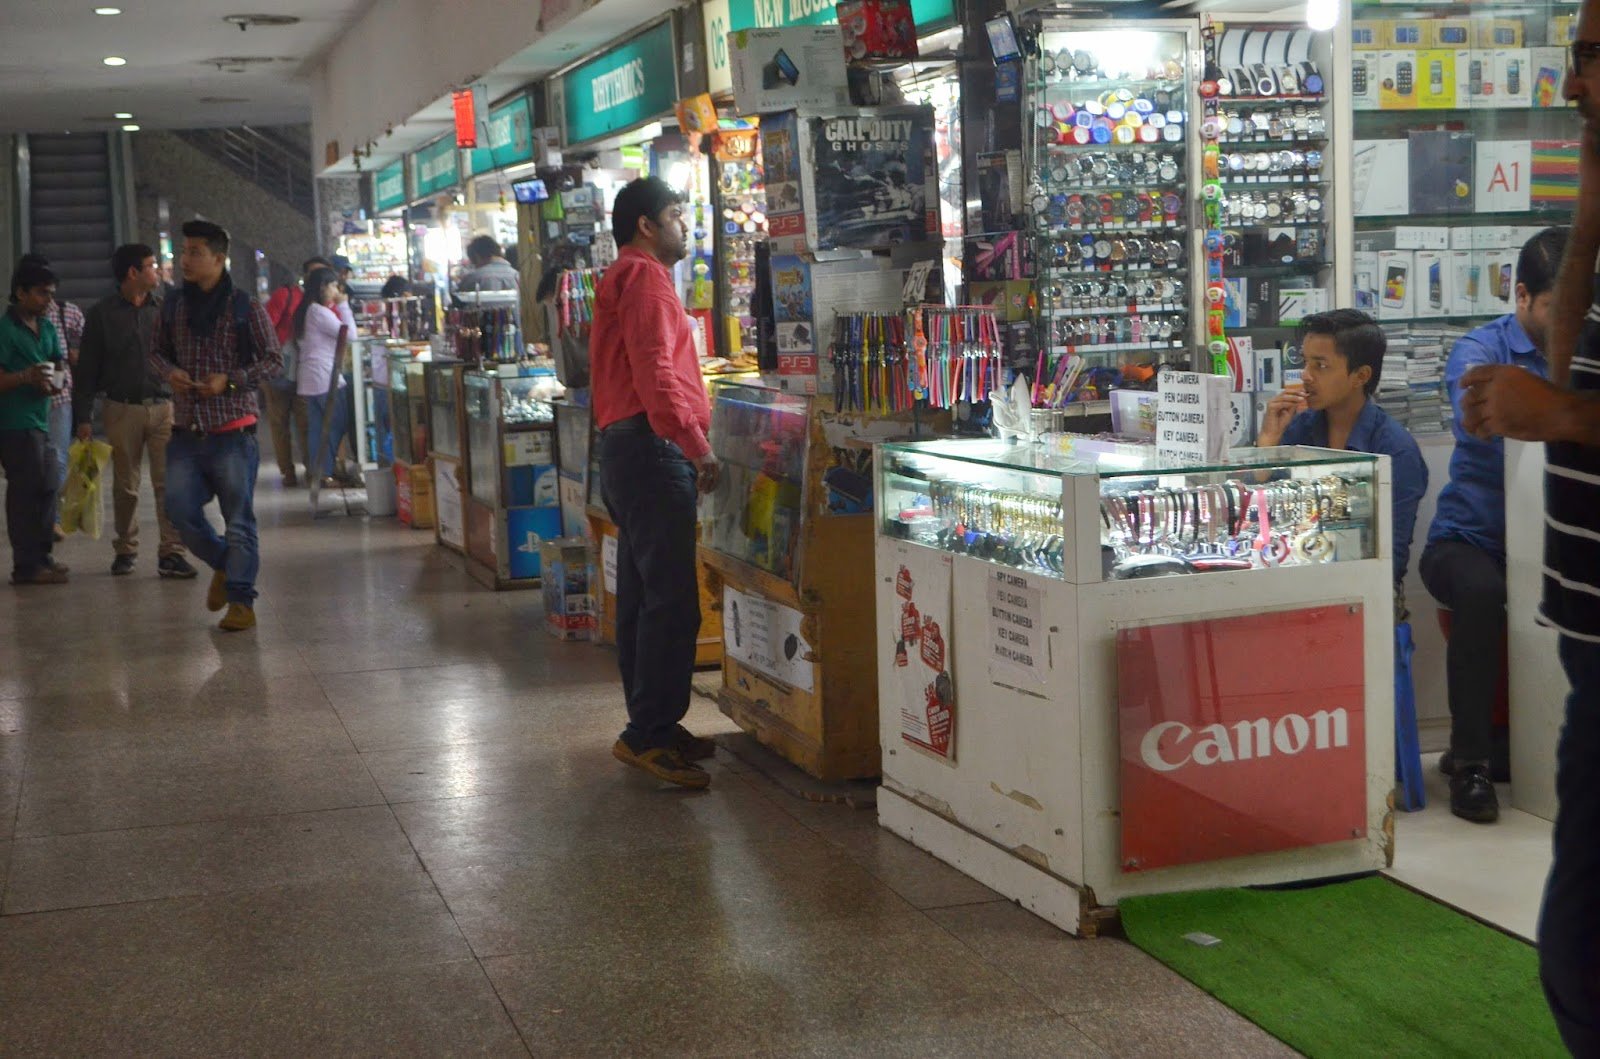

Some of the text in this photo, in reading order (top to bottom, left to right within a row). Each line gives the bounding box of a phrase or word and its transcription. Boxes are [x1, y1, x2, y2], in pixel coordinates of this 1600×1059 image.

[825, 119, 912, 141] CALL DUTY
[831, 141, 909, 152] GHOSTS
[1487, 162, 1520, 192] A1
[770, 214, 800, 230] PS3
[780, 355, 811, 368] PS3
[1176, 374, 1200, 385] CAMERA
[1164, 392, 1175, 403] PEN
[1176, 393, 1200, 404] CAMERA
[1158, 411, 1204, 424] BUTTON CAMERA
[1163, 430, 1199, 443] KEY CAMERA
[1007, 574, 1027, 589] CAMERA
[1007, 593, 1027, 608] CAMERA
[1012, 613, 1033, 629] CAMERA
[1009, 631, 1029, 646] CAMERA
[1012, 650, 1033, 667] CAMERA
[1140, 707, 1348, 771] Canon
